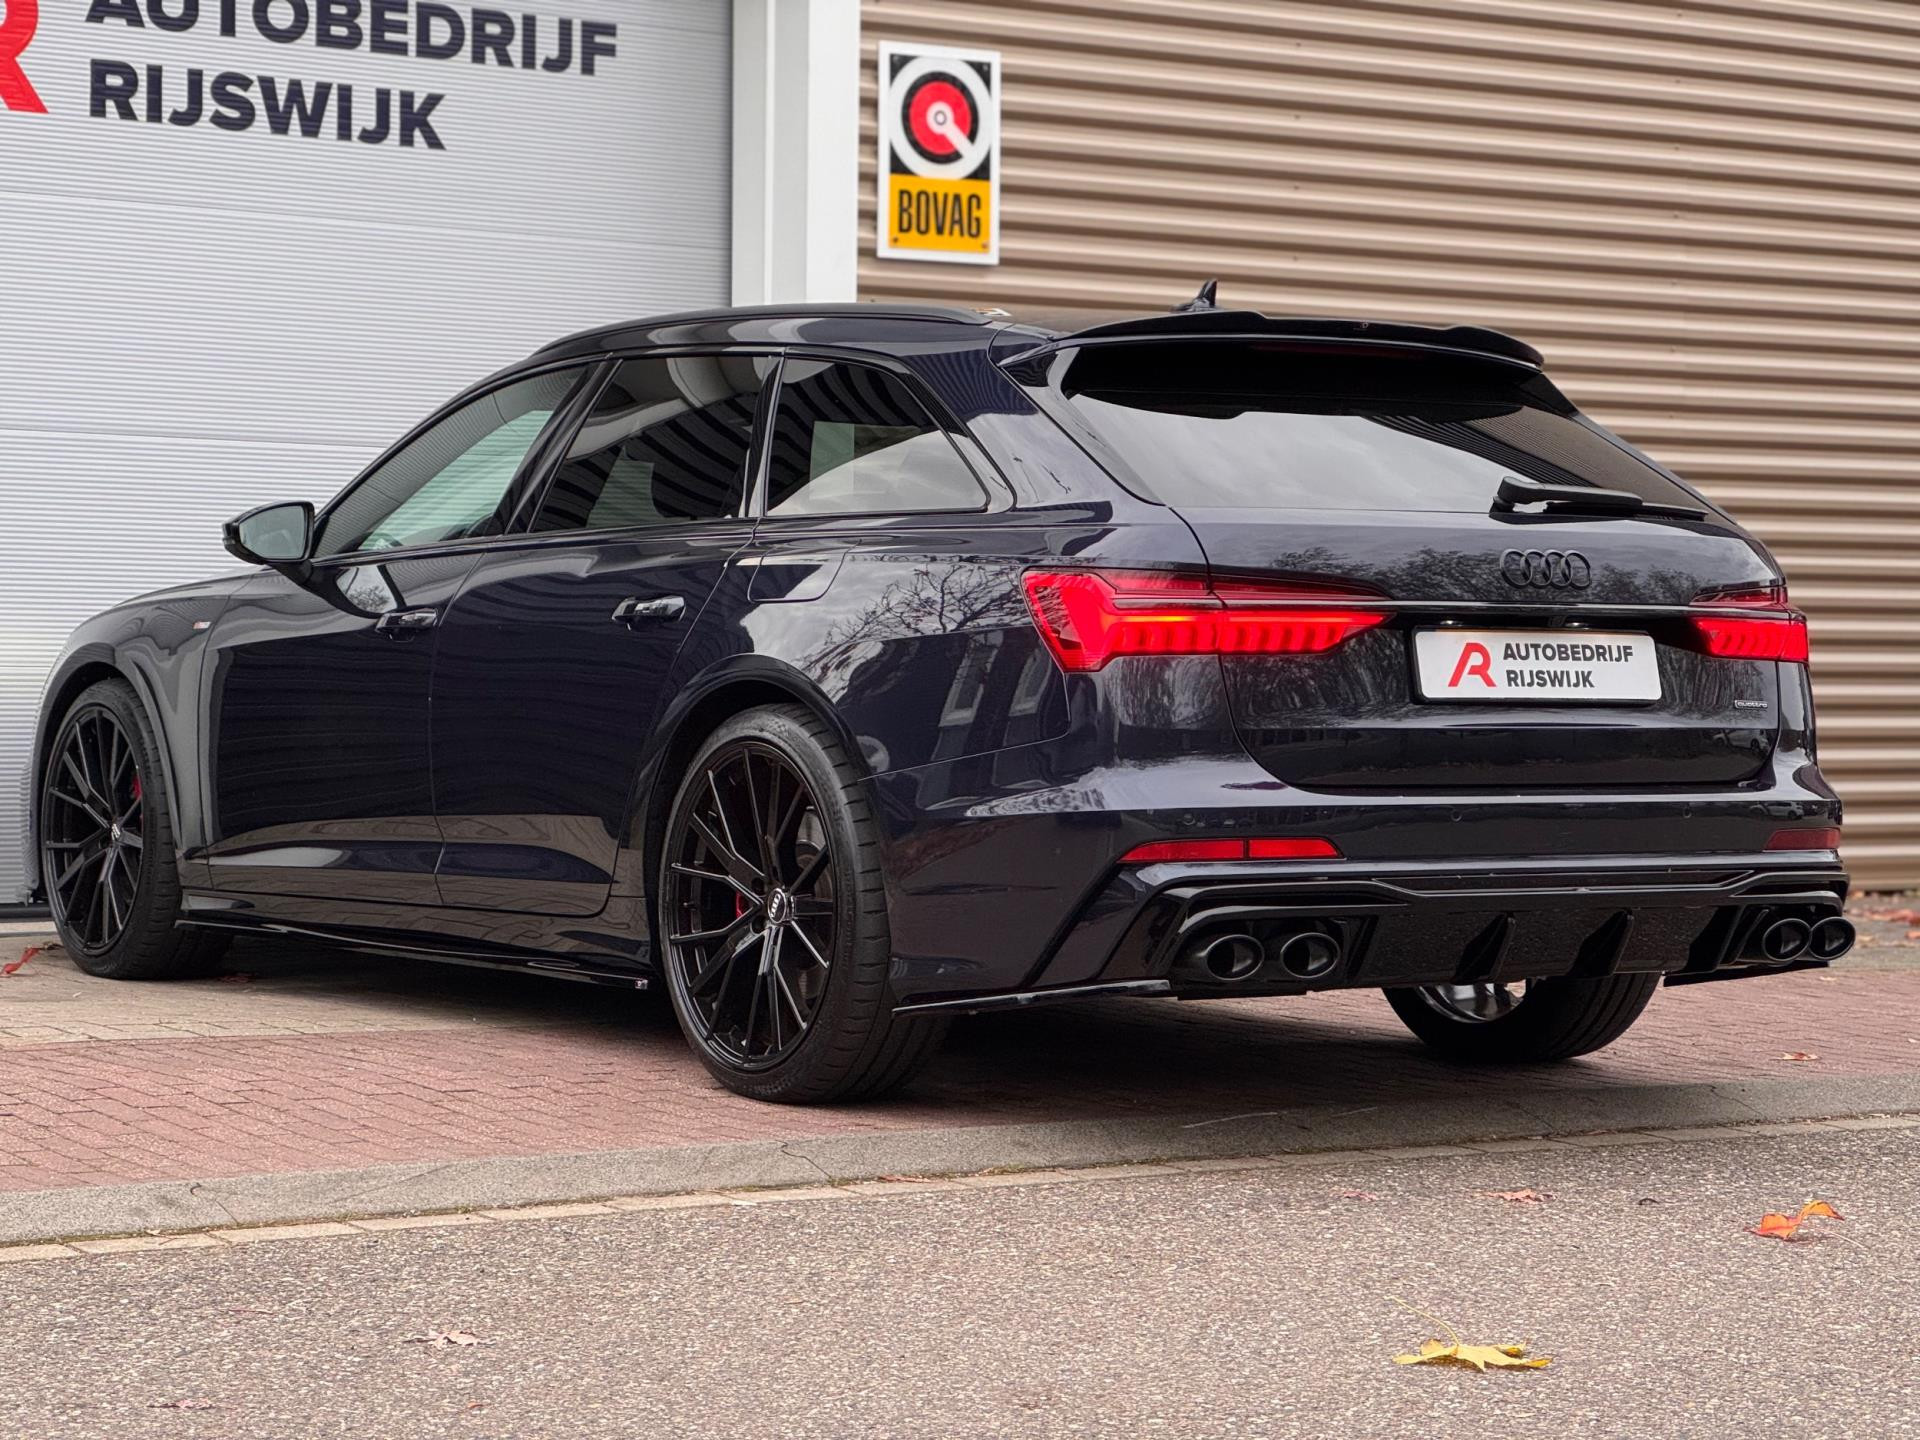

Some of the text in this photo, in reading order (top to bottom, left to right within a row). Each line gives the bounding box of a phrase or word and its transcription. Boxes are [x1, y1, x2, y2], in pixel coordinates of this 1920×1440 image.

[89, 58, 446, 150] RIJSWIJK
[898, 189, 982, 238] BOVAG
[1503, 642, 1633, 662] AUTOBEDRIJF
[1506, 669, 1595, 688] RIJSWIJK
